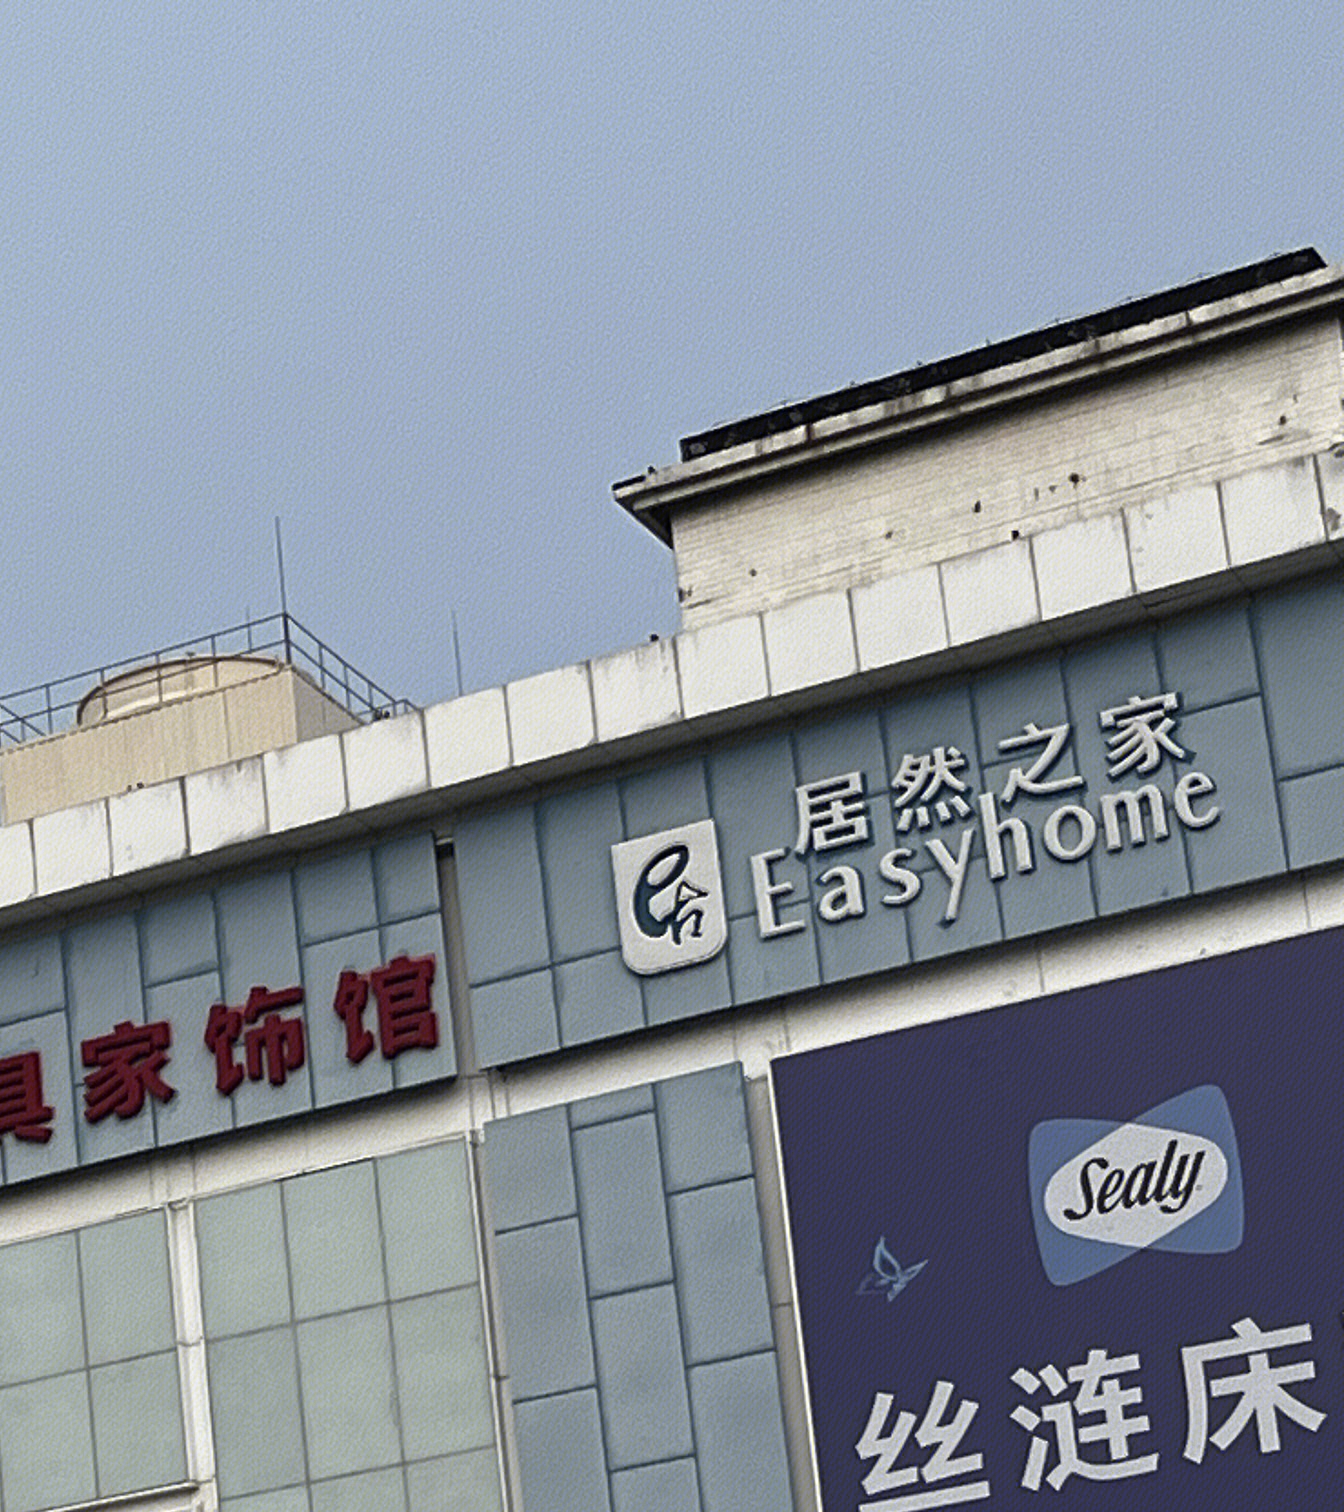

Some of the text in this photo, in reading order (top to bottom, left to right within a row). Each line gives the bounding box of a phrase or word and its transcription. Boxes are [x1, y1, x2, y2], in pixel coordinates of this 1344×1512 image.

[749, 769, 1220, 941] Easyhome
[794, 690, 1188, 858] 居然之家
[1062, 1139, 1206, 1221] Sealy
